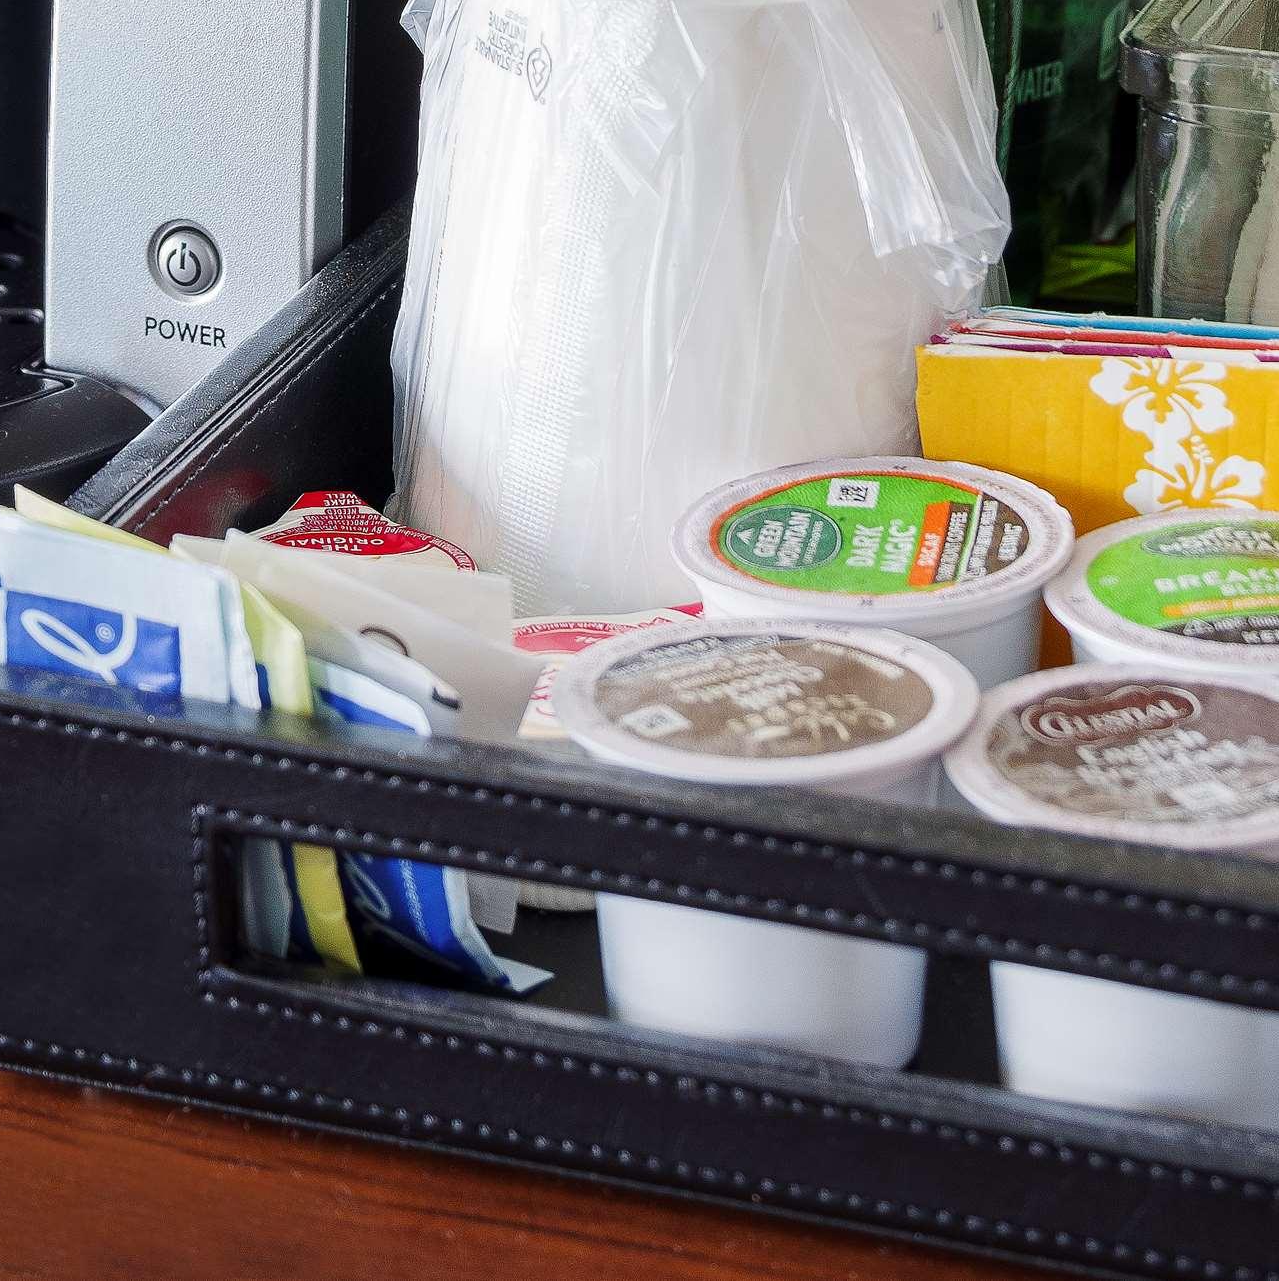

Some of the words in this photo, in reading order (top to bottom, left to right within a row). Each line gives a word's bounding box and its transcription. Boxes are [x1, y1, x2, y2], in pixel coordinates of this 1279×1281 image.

[145, 316, 227, 348] POWER
[322, 498, 362, 506] SHAKE
[326, 492, 359, 500] WELL
[285, 536, 385, 548] ORIGINAL
[321, 543, 363, 553] THE
[753, 519, 785, 558] GREEN
[776, 511, 812, 568] MOUNTAIN
[845, 523, 884, 568] DARK
